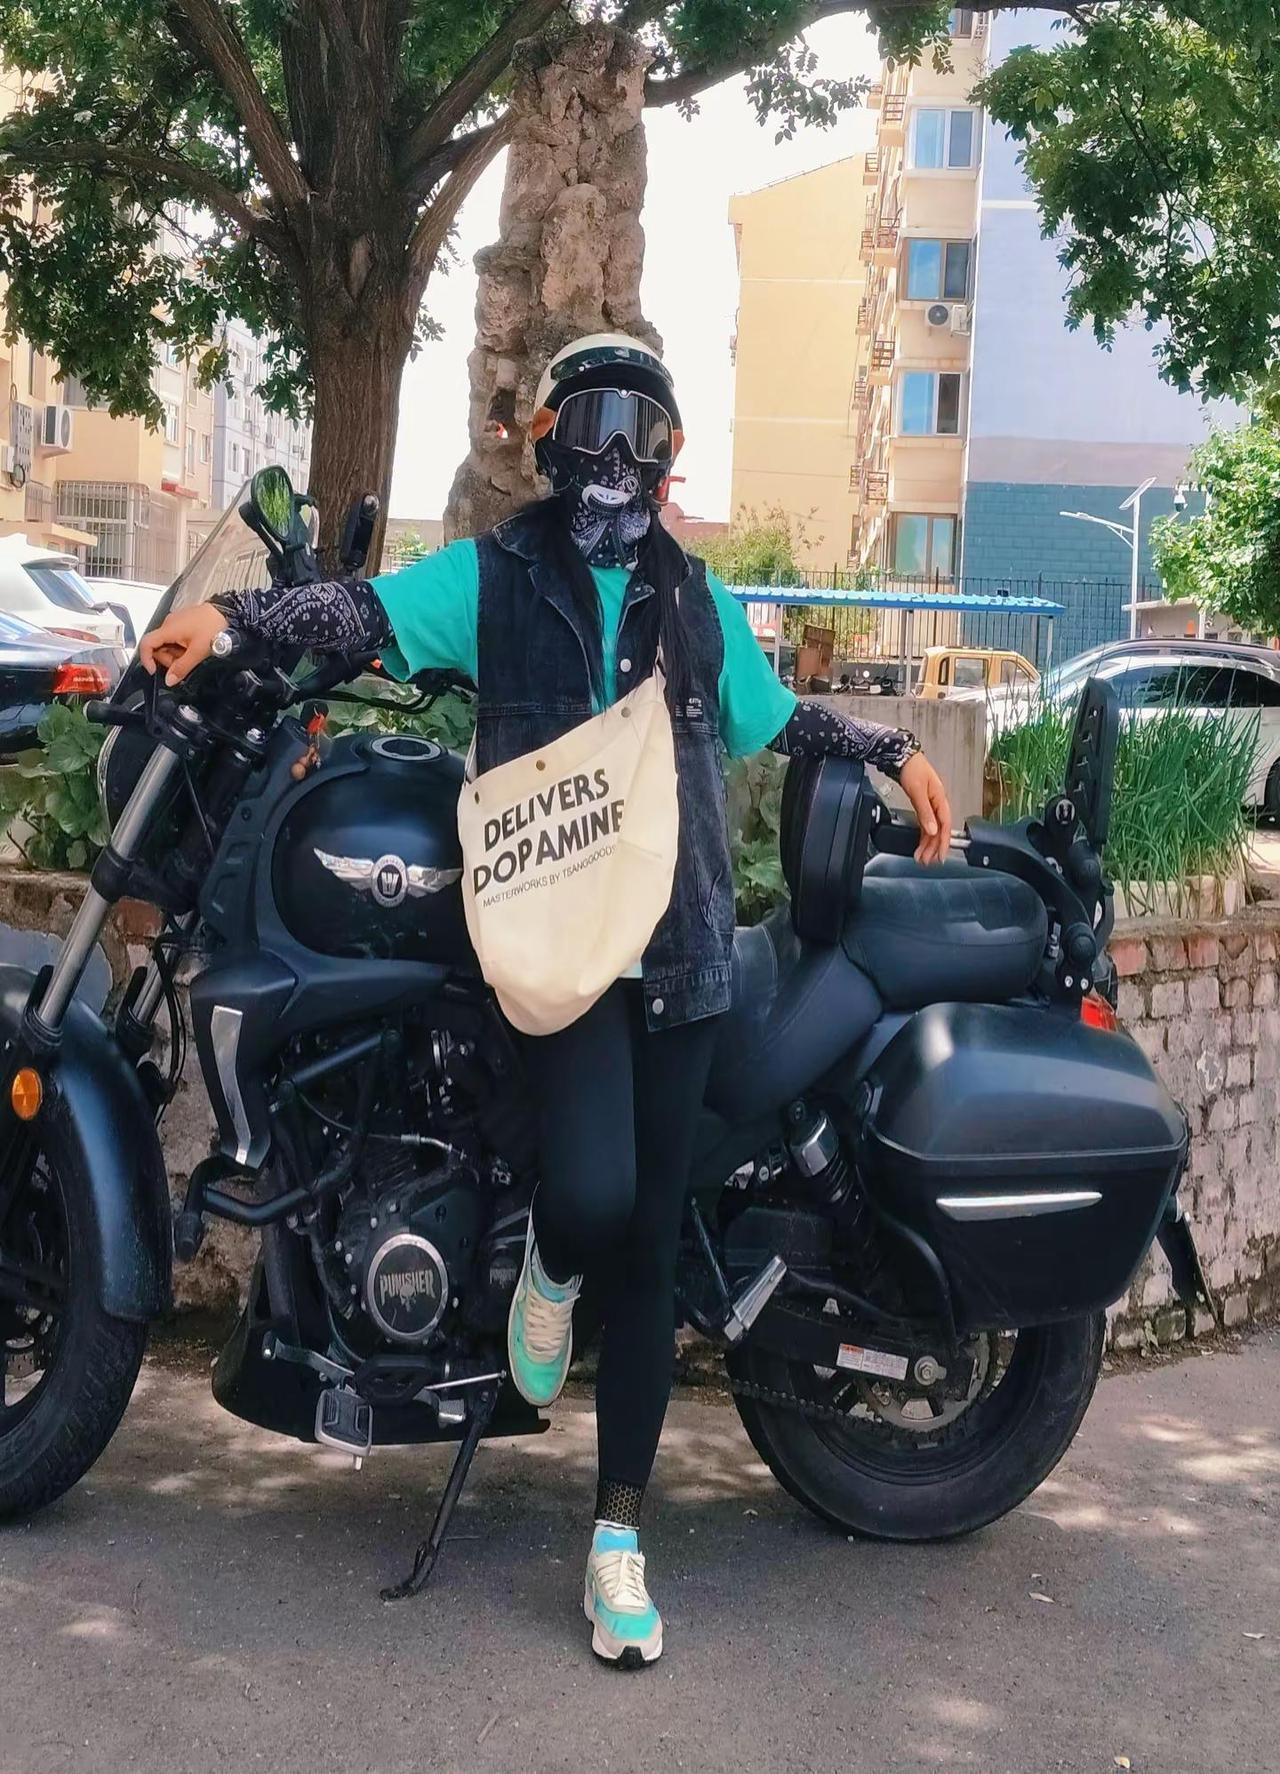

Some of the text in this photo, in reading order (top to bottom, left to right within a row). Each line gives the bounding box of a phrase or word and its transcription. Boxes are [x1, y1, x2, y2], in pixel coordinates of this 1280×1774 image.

[473, 799, 625, 896] DOPAMINE
[484, 768, 610, 852] DELIVERS
[483, 876, 548, 908] MASTERWORKS
[549, 872, 560, 886] BY
